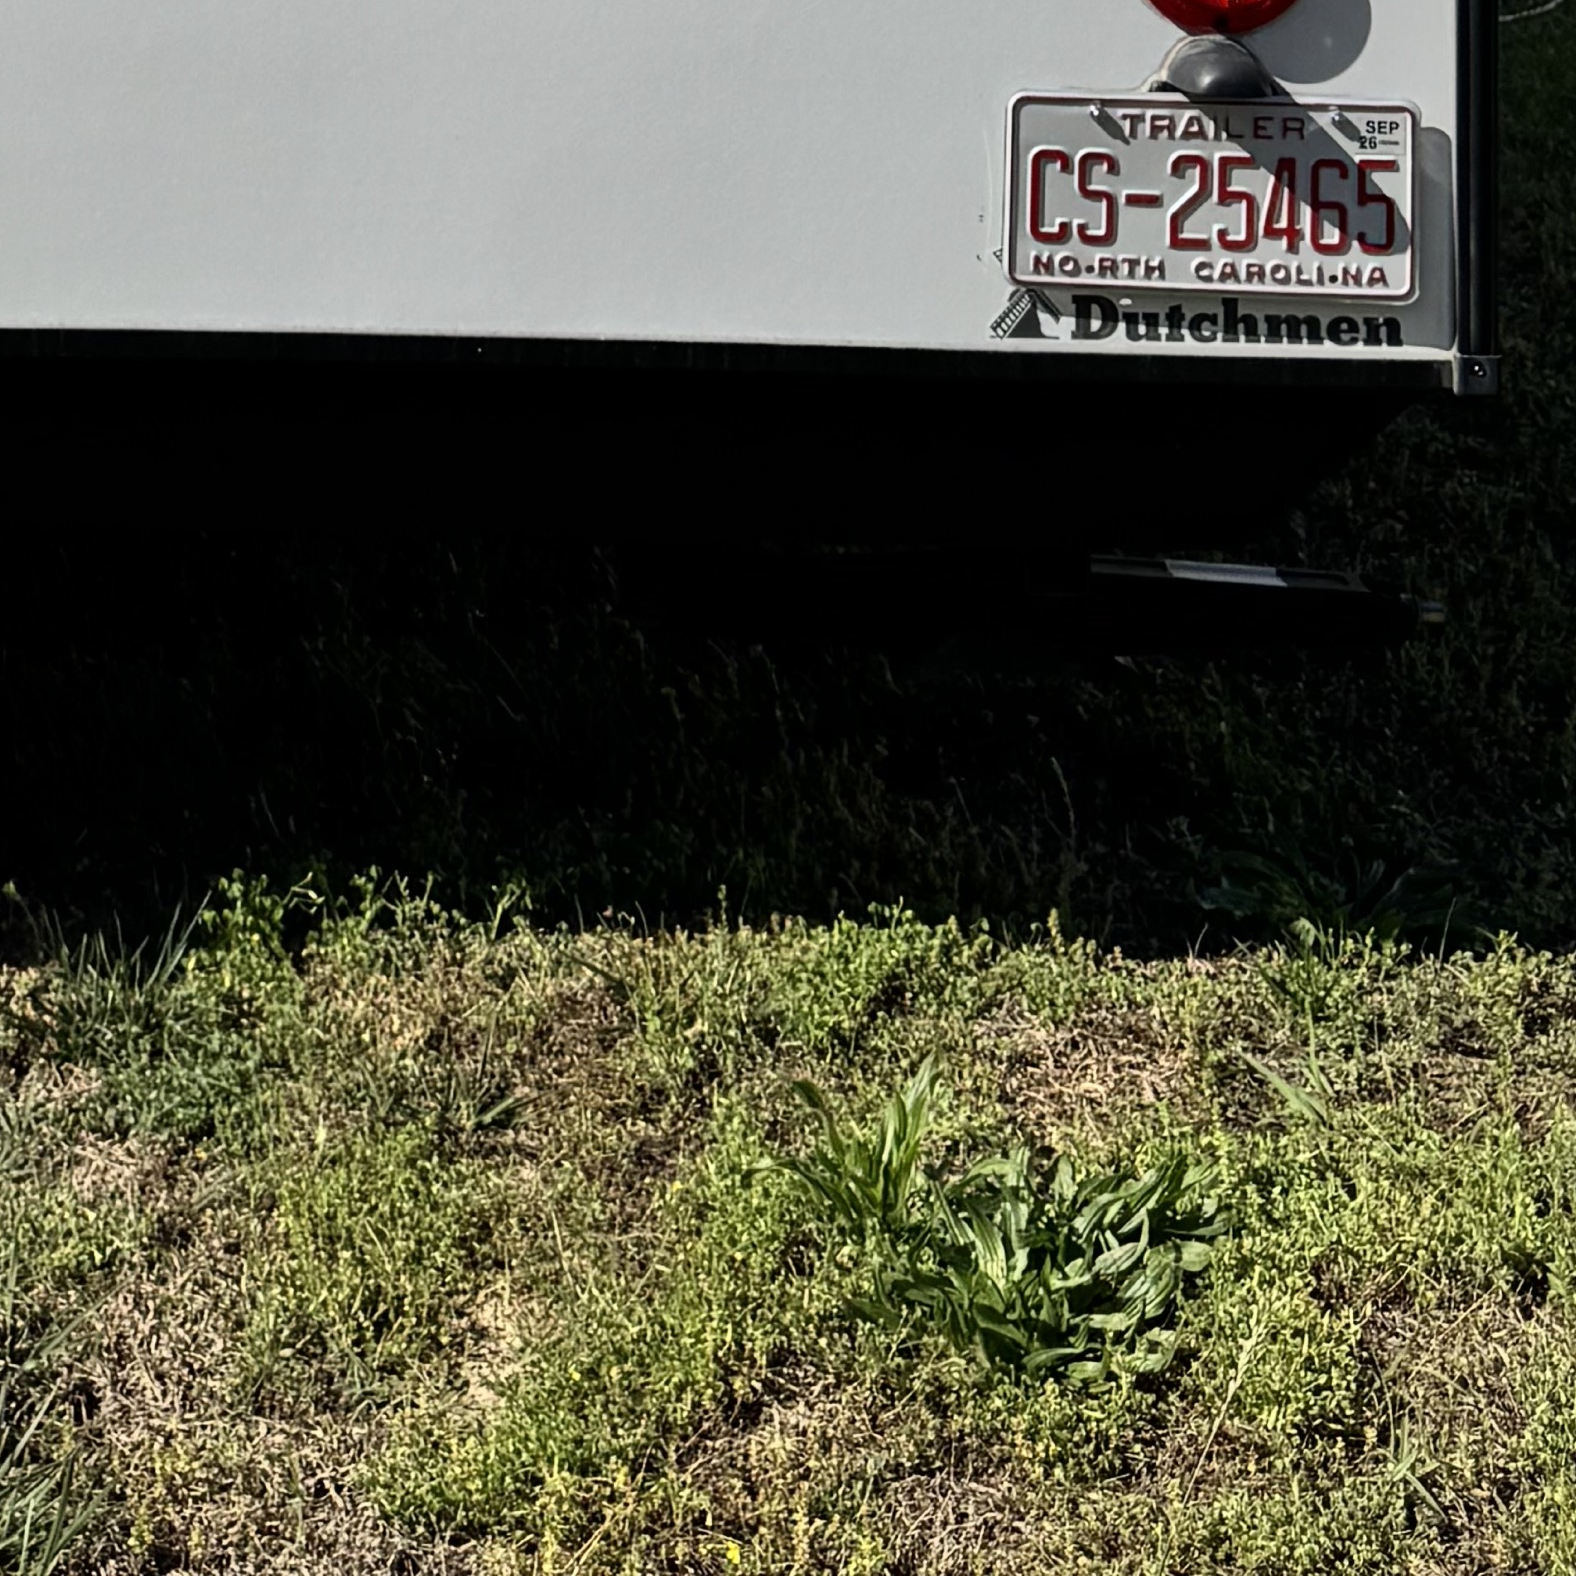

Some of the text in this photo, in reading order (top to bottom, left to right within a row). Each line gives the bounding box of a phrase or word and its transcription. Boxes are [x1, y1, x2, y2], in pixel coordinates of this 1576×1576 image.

[1120, 110, 1306, 141] TRAILER
[1365, 120, 1401, 135] SEP
[1029, 147, 1401, 255] CS-25465
[1030, 251, 1389, 288] NORTH CAROLINA
[1071, 294, 1403, 347] Dutchmen
